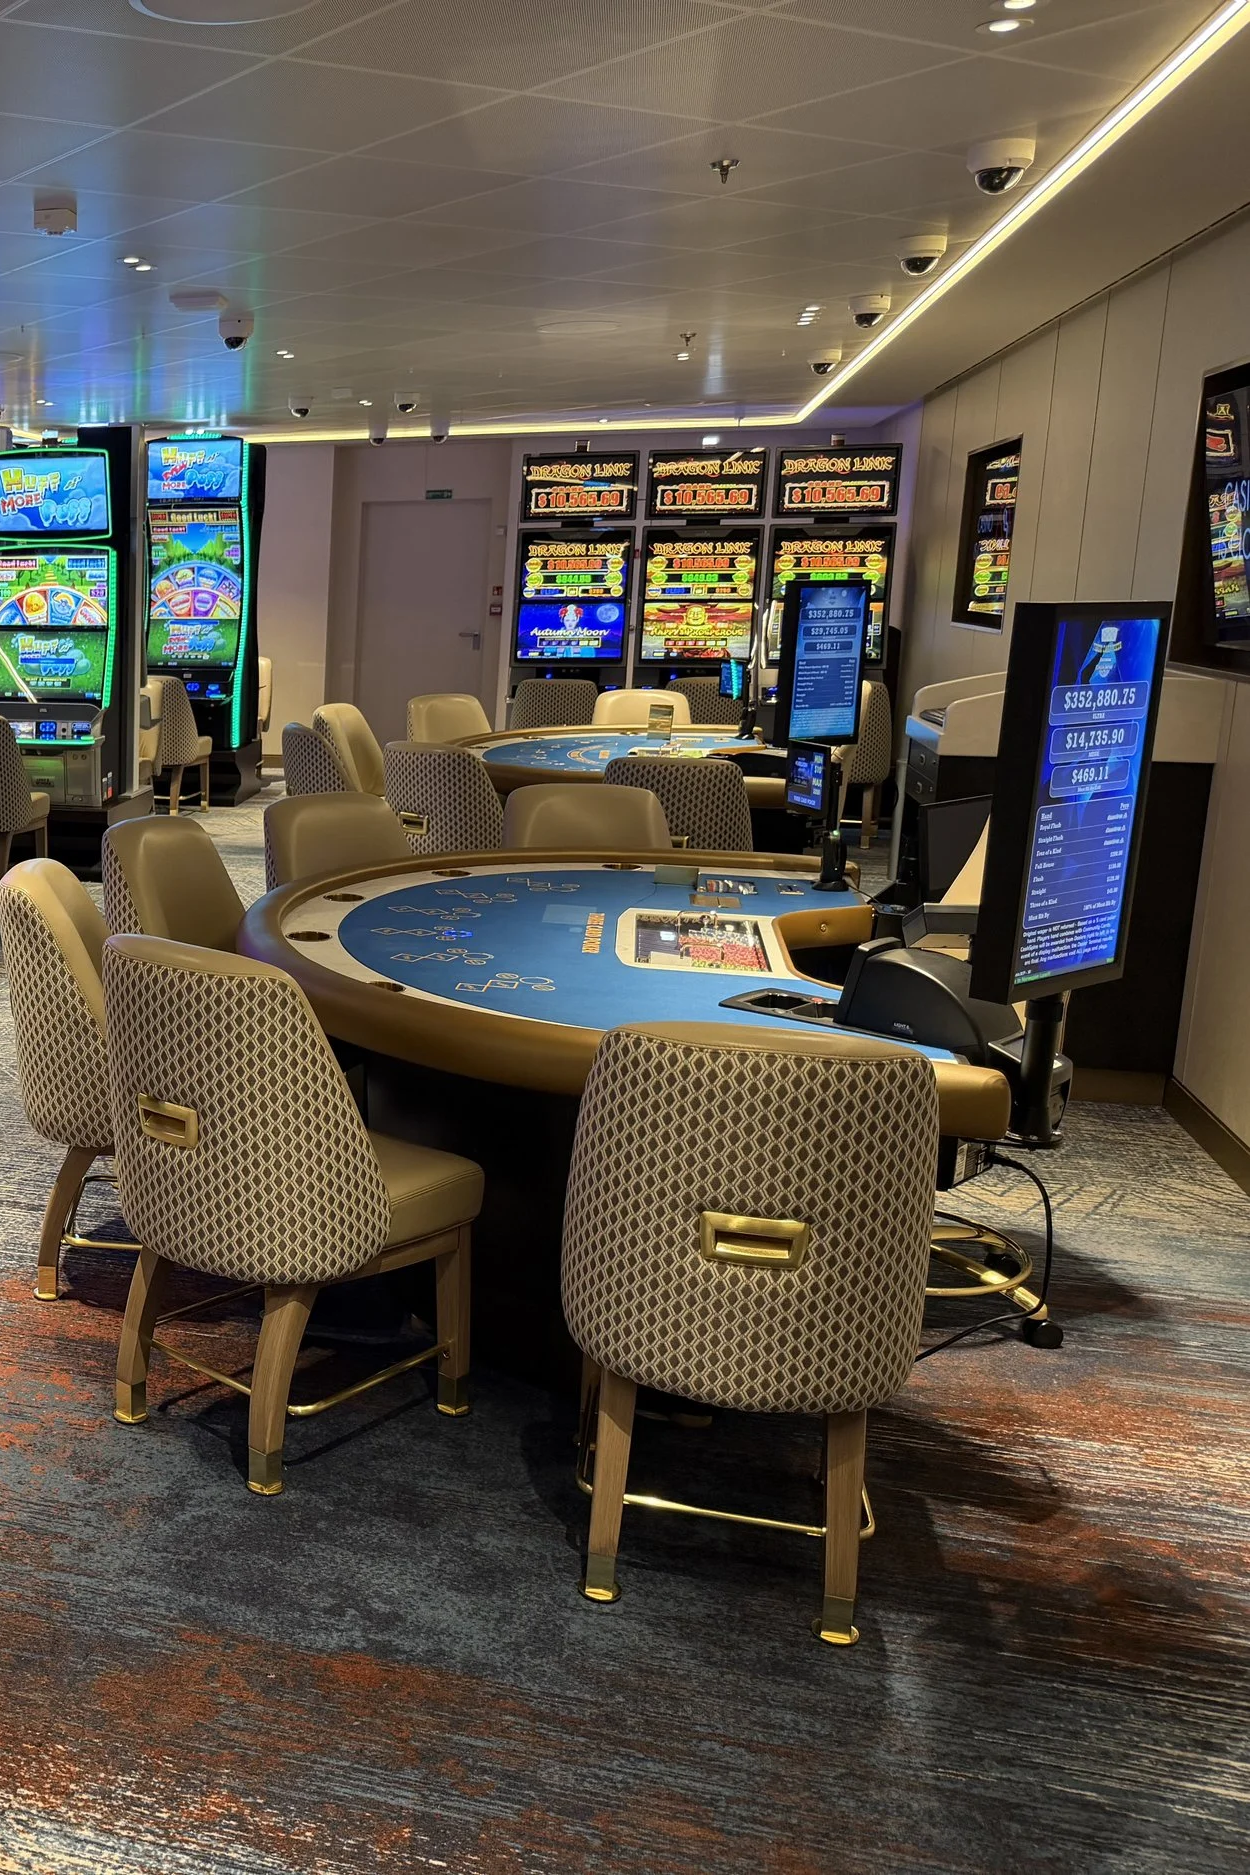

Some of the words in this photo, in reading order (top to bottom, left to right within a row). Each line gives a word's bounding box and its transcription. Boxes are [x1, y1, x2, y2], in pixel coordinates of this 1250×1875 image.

[530, 463, 592, 479] DRAGON
[594, 463, 632, 477] LINK
[656, 461, 721, 476] DRAGON
[722, 459, 761, 475] LINK
[782, 457, 851, 474] DRAGON
[852, 457, 894, 472] LINK
[161, 480, 187, 492] MORE
[0, 491, 44, 515] MORE
[528, 544, 586, 556] DRAGON
[587, 543, 623, 556] LINK
[653, 542, 714, 554] DRAGON
[715, 542, 751, 554] LINK
[780, 540, 843, 554] DRAGON
[845, 540, 883, 553] LINK
[530, 627, 577, 637] Autumn
[577, 627, 610, 636] Moon
[1064, 687, 1136, 711] $352,880.75
[1065, 728, 1125, 750] $14,735.90
[1071, 766, 1109, 784] $469.11
